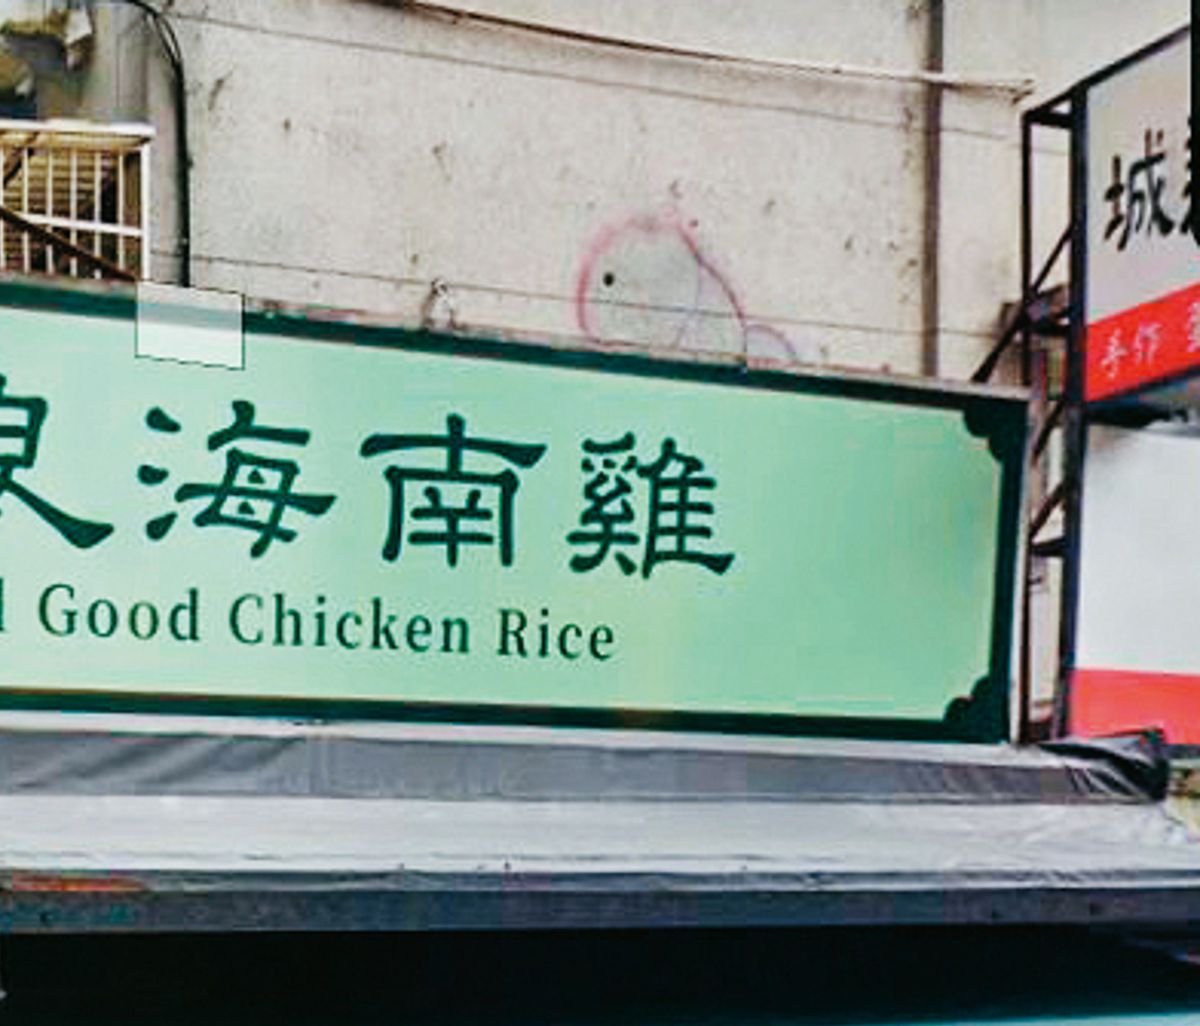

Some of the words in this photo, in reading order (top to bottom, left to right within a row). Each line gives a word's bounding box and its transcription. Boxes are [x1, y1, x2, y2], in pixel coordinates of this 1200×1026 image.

[38, 583, 200, 642] Good
[228, 592, 471, 655] Chicken
[496, 607, 615, 662] Rice
